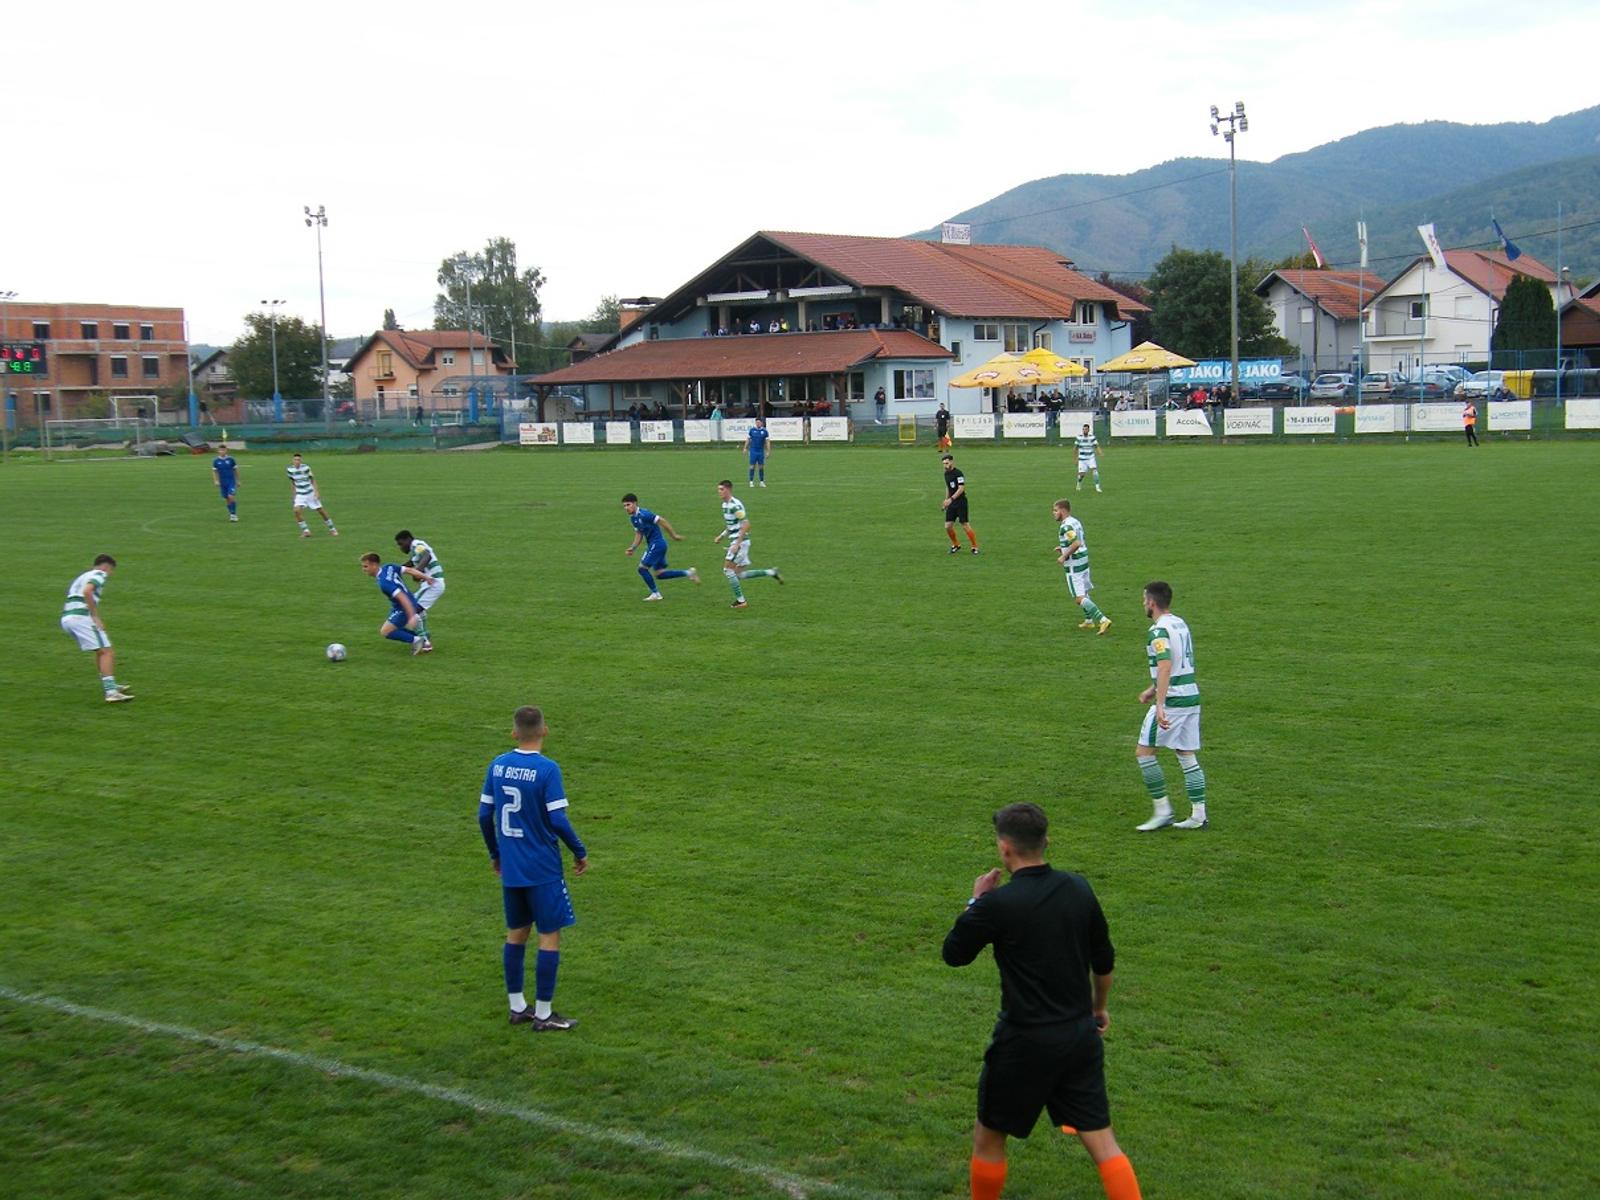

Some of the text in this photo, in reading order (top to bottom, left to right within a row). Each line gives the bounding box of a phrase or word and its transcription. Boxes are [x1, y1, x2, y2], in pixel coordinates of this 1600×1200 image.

[1189, 365, 1223, 379] JAKO
[1245, 364, 1280, 378] JAKO
[1179, 632, 1194, 669] 14
[492, 764, 537, 782] NK BISTRA
[502, 785, 524, 838] 2
